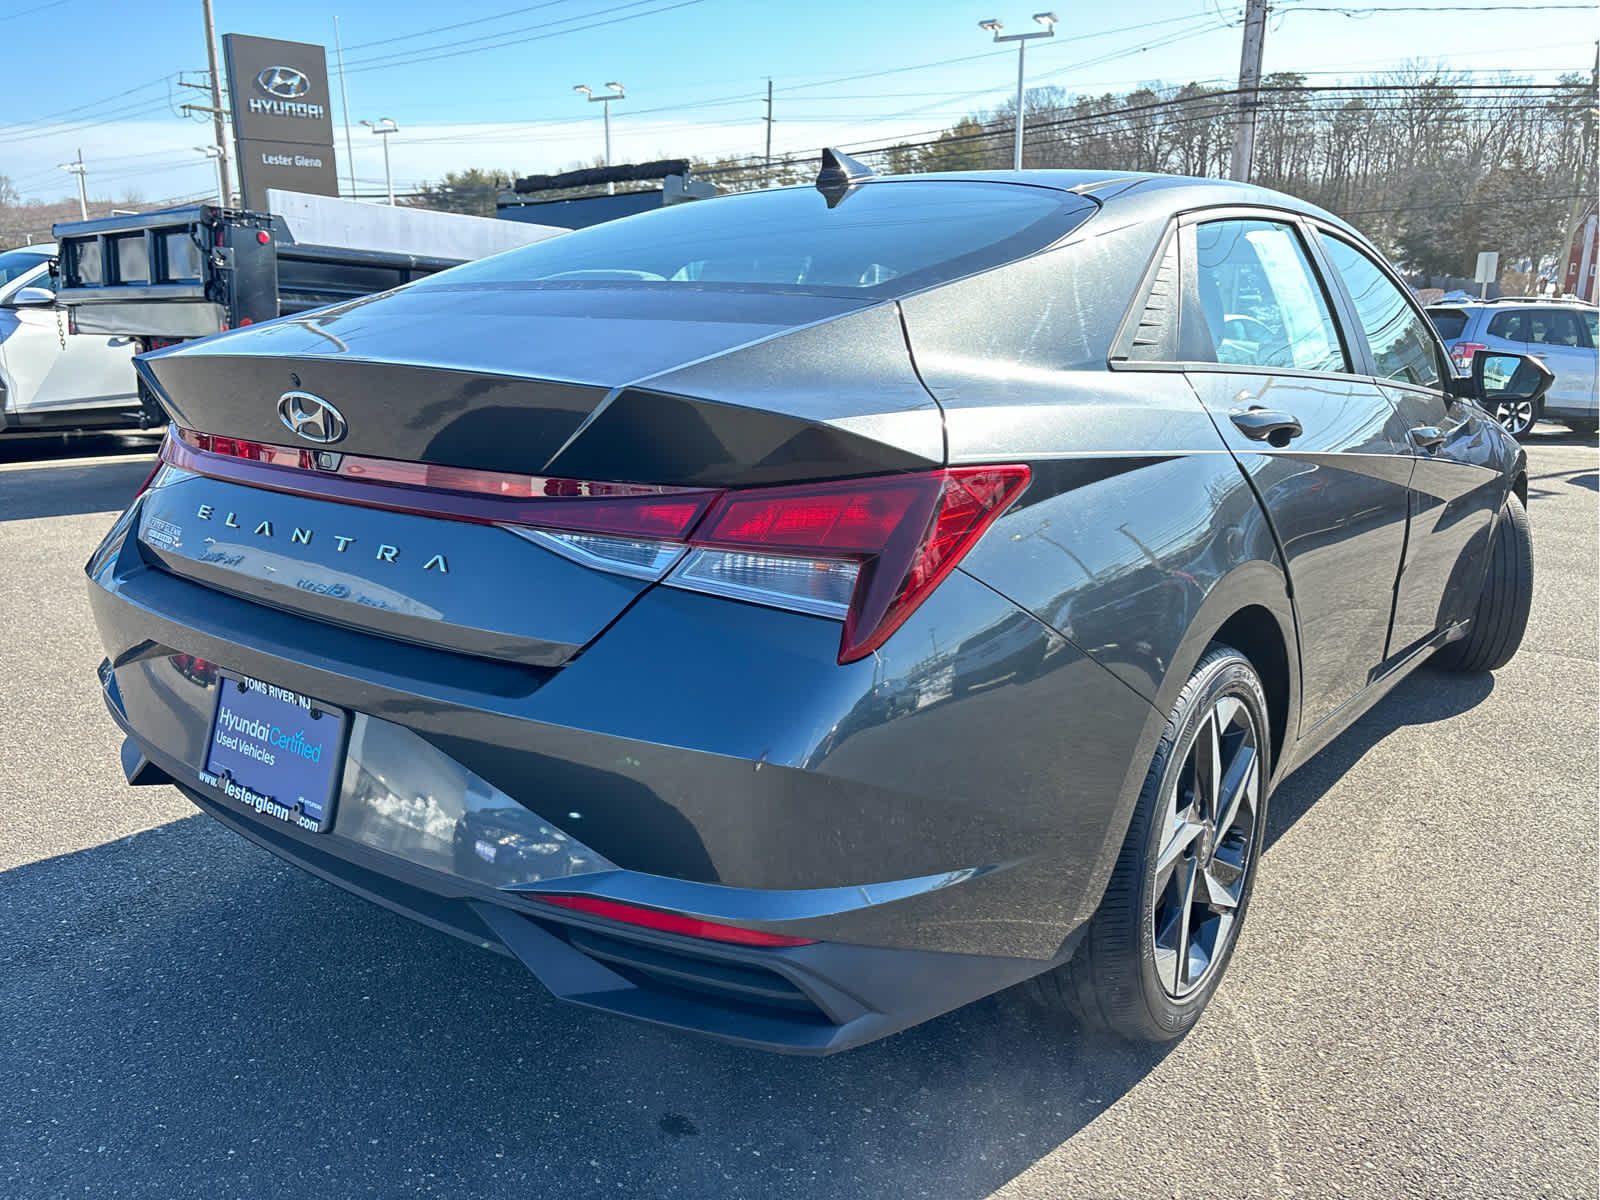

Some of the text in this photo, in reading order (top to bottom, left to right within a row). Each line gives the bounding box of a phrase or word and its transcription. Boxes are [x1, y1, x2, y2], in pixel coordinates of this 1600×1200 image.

[250, 98, 324, 119] HYUNDAI
[261, 152, 322, 168] Lester Glenn
[197, 504, 449, 573] ELANTRA
[244, 676, 268, 695] TOMS
[299, 695, 312, 710] NJ
[216, 730, 276, 766] Used Vehicles
[219, 706, 322, 763] Hyundai Certified
